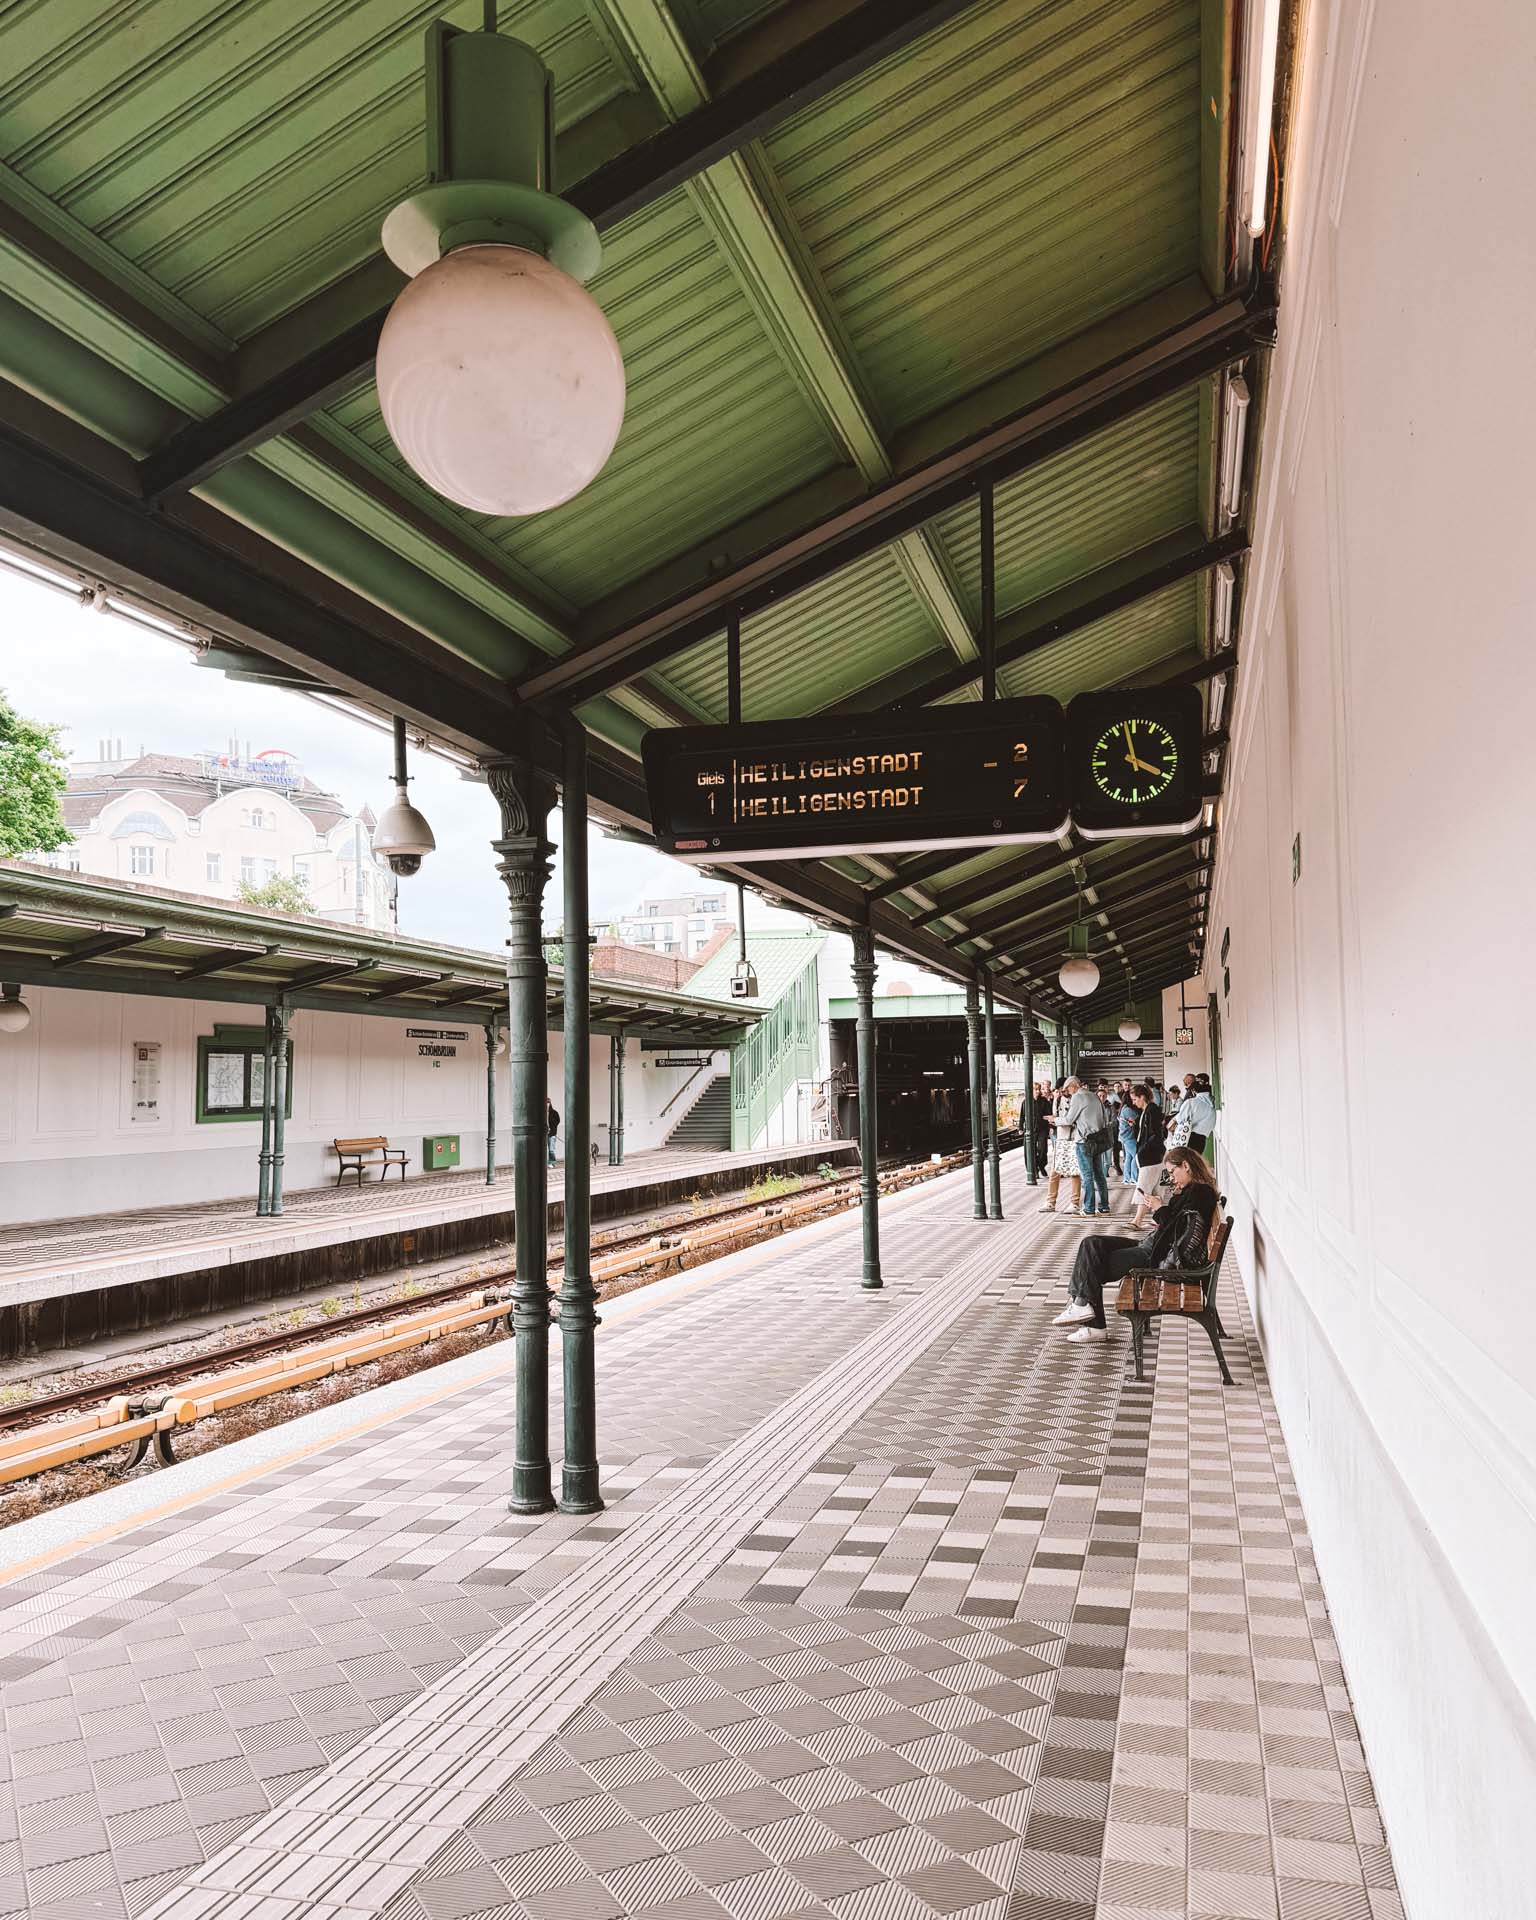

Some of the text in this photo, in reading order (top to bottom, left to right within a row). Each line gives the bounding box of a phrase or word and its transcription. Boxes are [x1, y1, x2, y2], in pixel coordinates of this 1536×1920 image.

[740, 752, 923, 784] HEILIGENSTADT
[1013, 742, 1028, 762] 2
[697, 771, 725, 786] Gleis
[707, 791, 715, 815] 1
[740, 778, 1028, 817] HEILIGENSTADT 7
[418, 1041, 456, 1057] SCHÖNBRUNN
